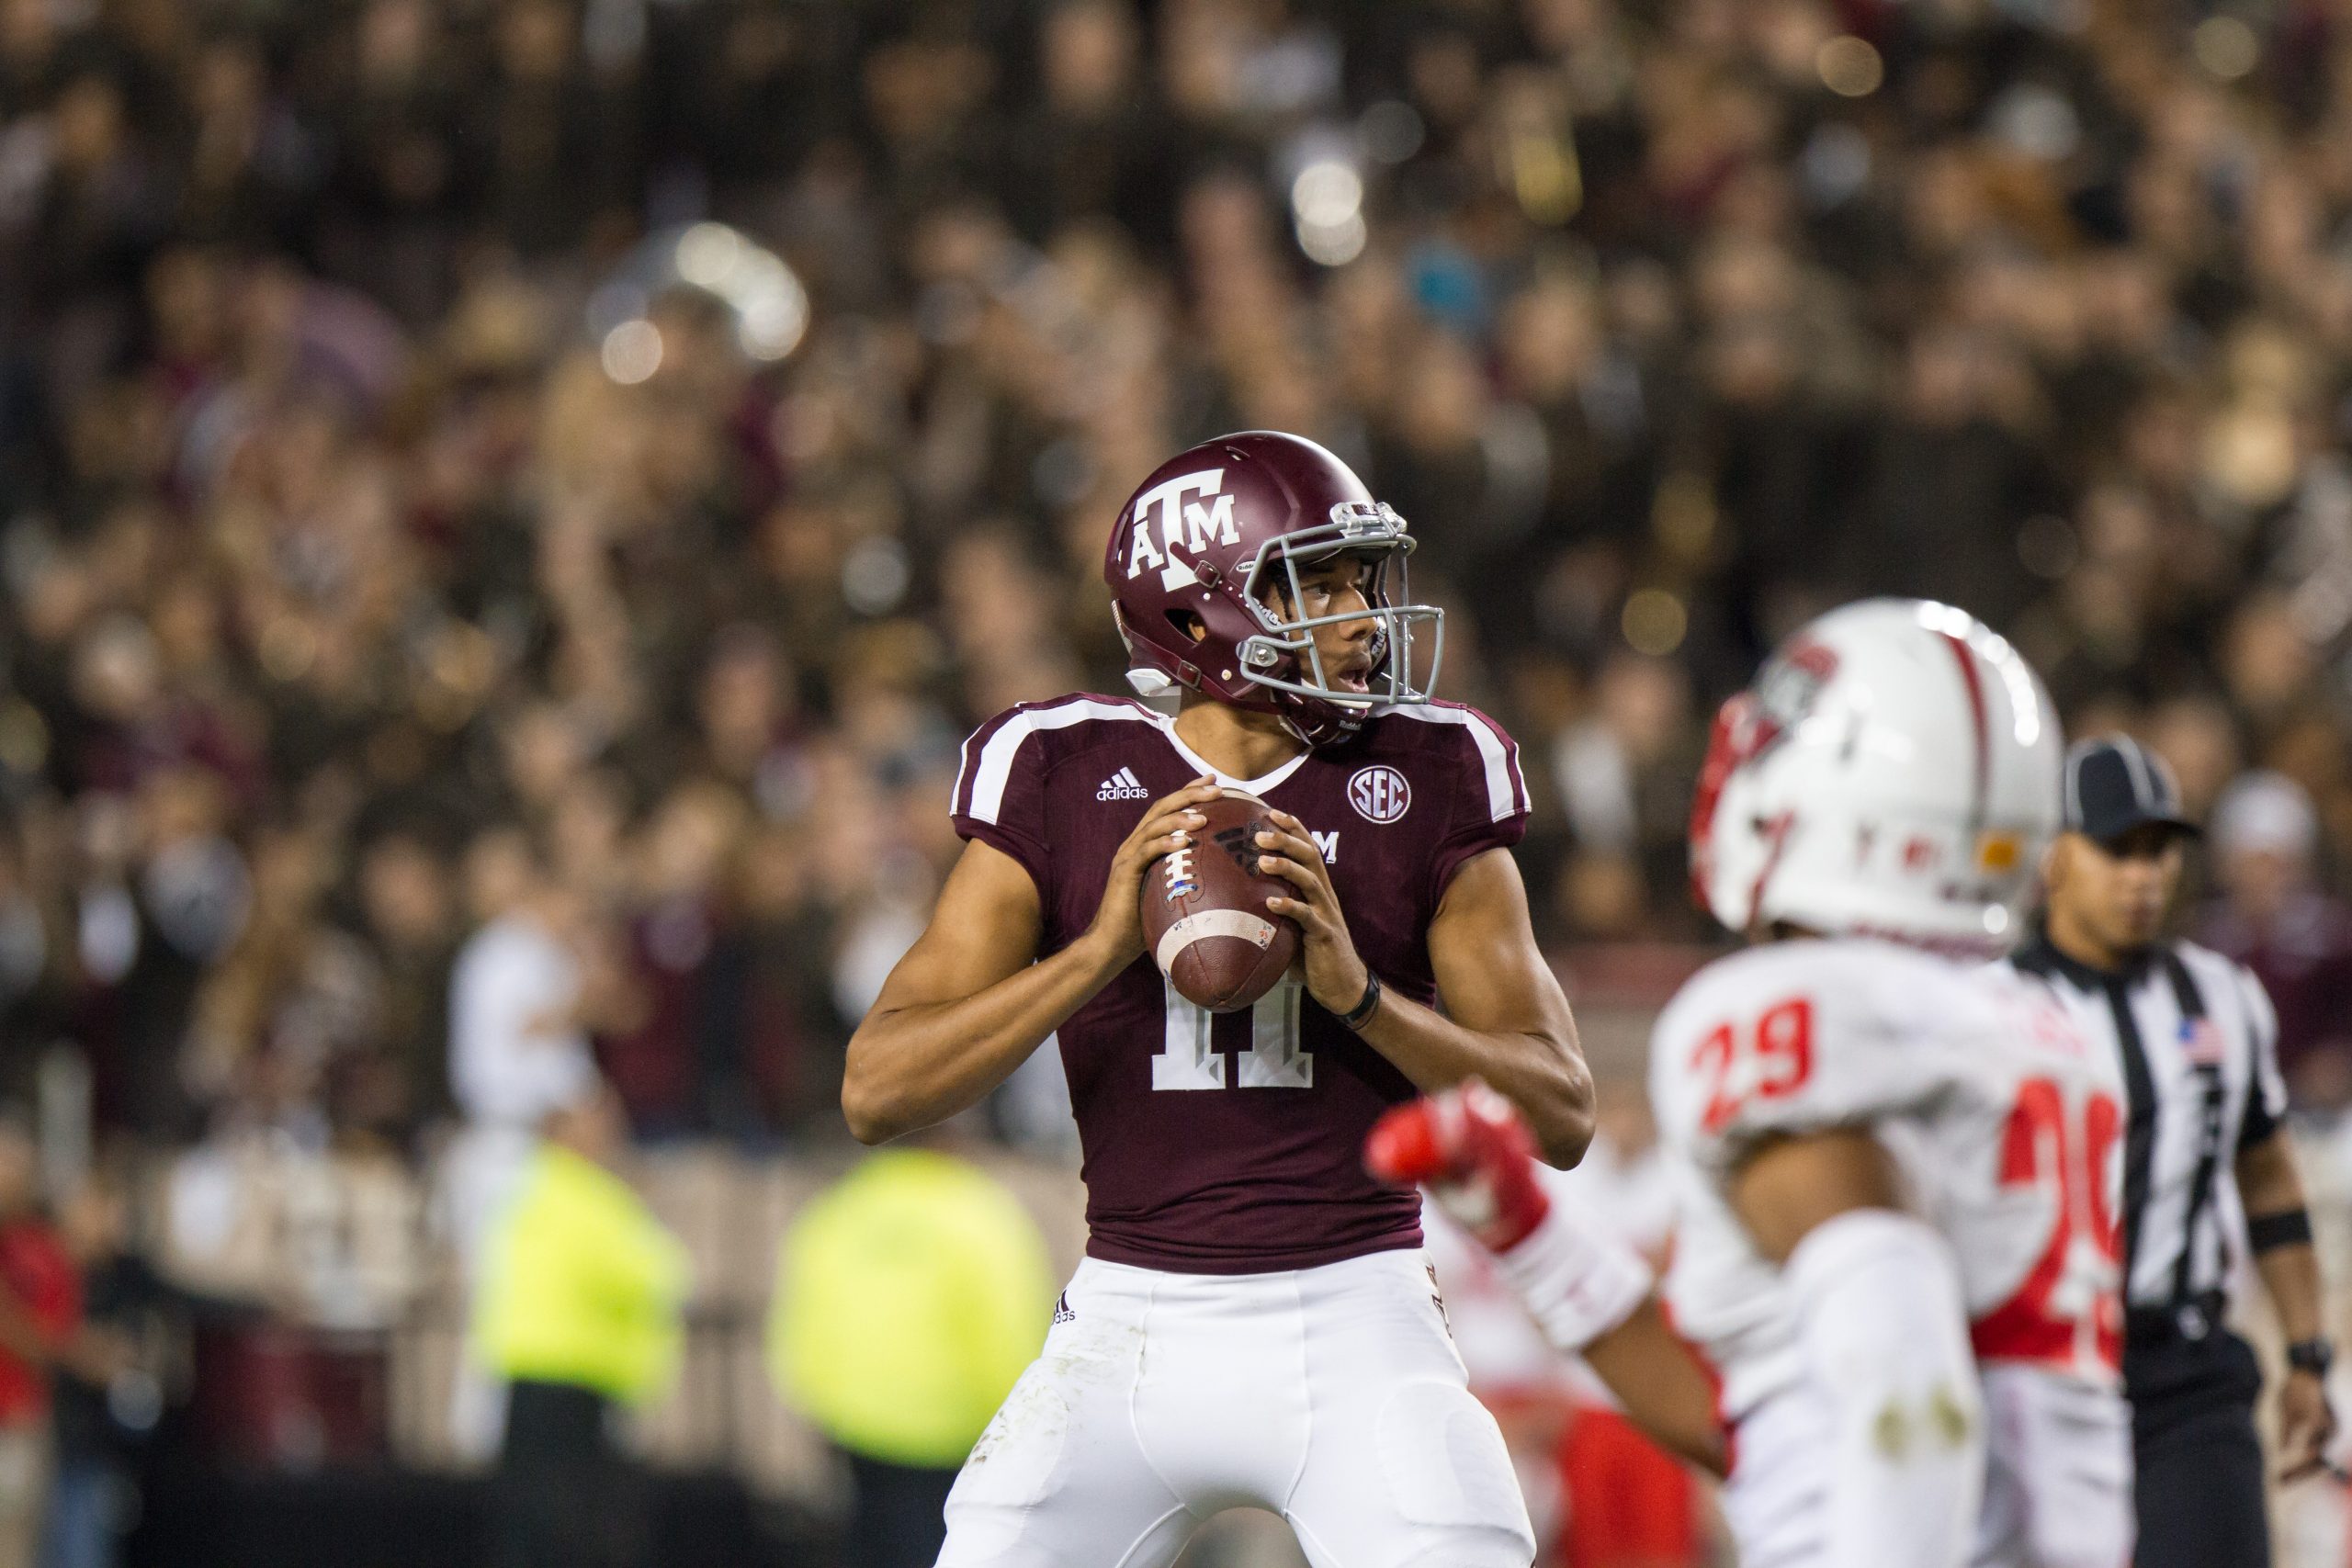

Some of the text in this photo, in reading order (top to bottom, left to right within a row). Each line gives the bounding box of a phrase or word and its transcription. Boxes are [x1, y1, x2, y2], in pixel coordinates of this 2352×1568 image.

[1096, 786, 1149, 801] adidas
[1353, 770, 1405, 818] SEC
[1152, 972, 1314, 1090] 11
[1687, 995, 1814, 1135] 29
